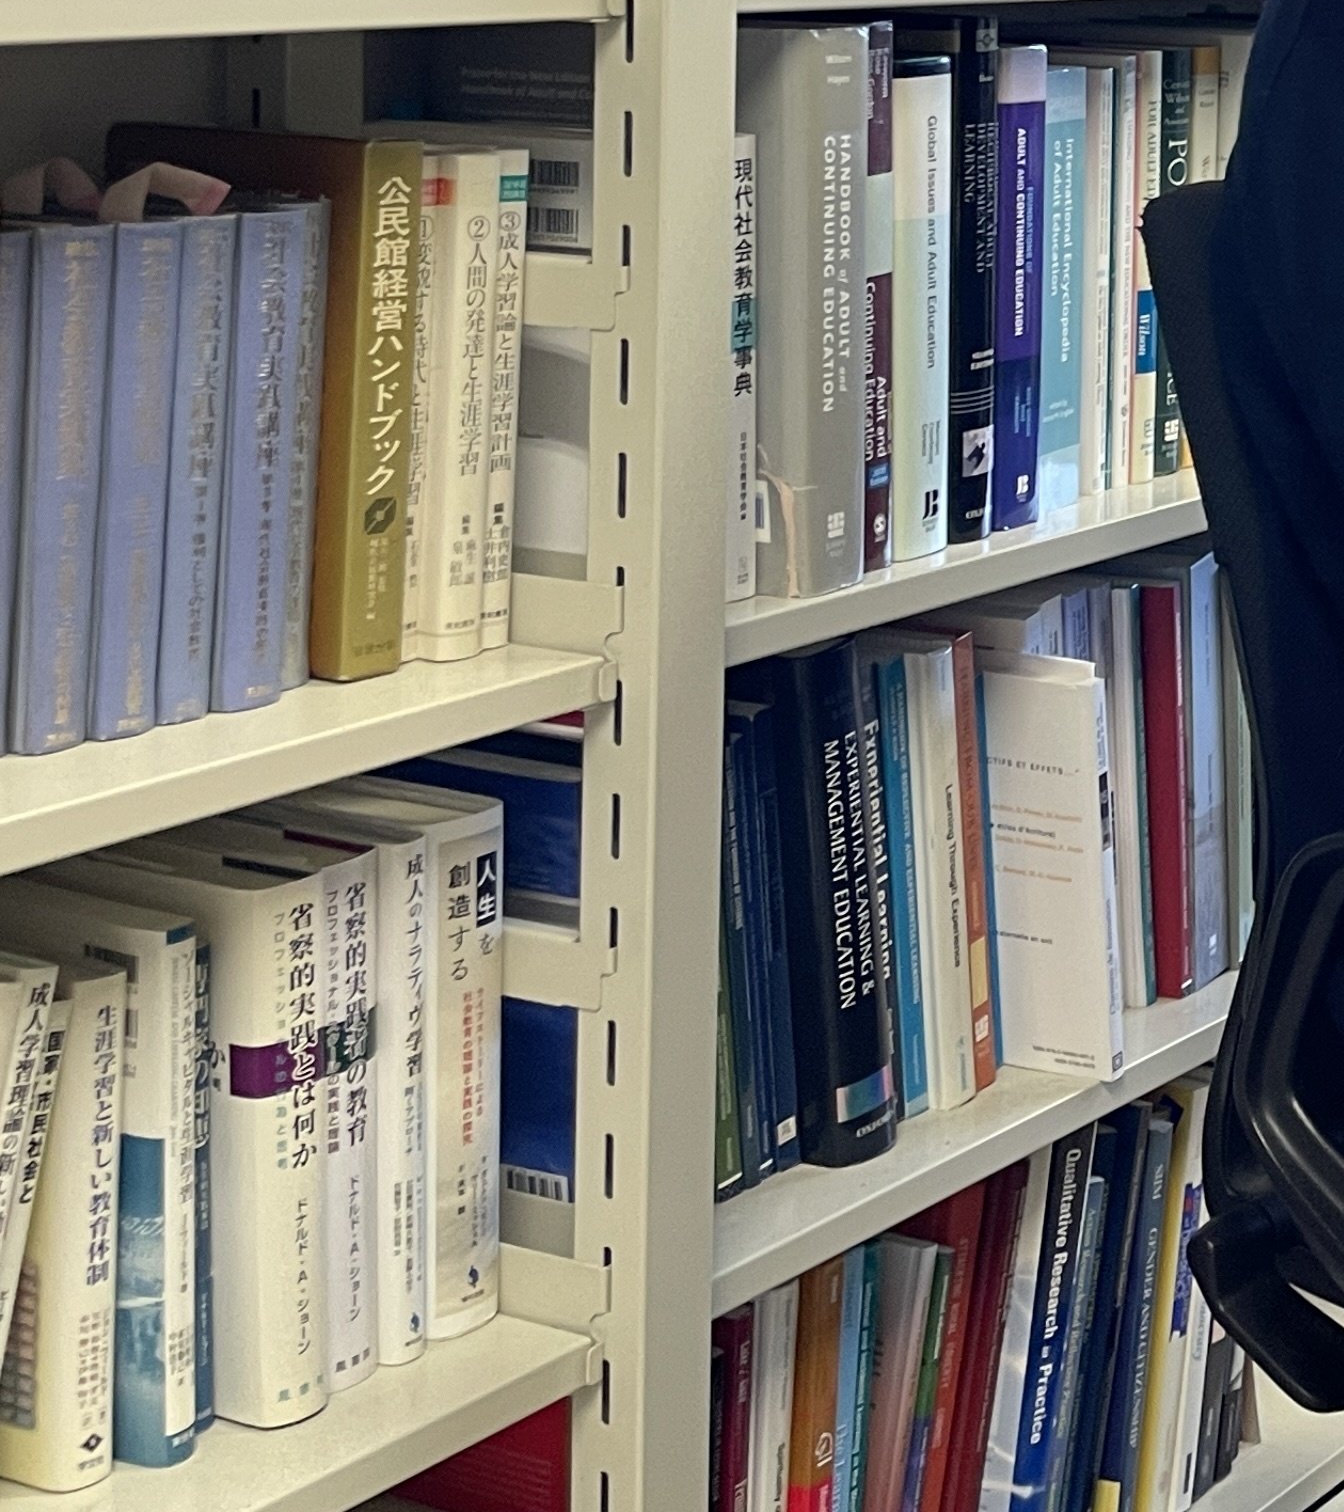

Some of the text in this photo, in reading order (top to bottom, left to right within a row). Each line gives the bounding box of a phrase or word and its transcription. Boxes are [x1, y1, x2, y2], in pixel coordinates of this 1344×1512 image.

[839, 134, 851, 260] HANDBOOK
[963, 123, 977, 203] LEARNING
[1052, 165, 1061, 208] Adult
[733, 157, 754, 397] 現代社会教育学事典
[822, 136, 836, 413] CONTINUING EDUCATION
[926, 115, 938, 369] Global Issues and Adult Education
[1014, 128, 1027, 337] ADULT AND CONTINUING EDUCATION
[1050, 212, 1060, 297] Education
[1060, 138, 1075, 363] International Encyclopedia
[367, 175, 412, 496] 公民館経営ハンドブック
[838, 290, 850, 359] ADULT
[875, 375, 888, 458] Adult and
[844, 730, 867, 872] EXPERIENTIAL
[447, 864, 471, 982] 創造する
[476, 858, 497, 956] 人生を
[823, 738, 857, 1010] MANAGEMENT EDUCATION
[855, 875, 875, 977] LEARNING
[945, 783, 961, 968] Learning Through Experience
[345, 882, 368, 1147] 省察的実践者の教育
[405, 852, 424, 1078] 成人のナラティヴ学習
[288, 902, 318, 1170] 省察的実践とは何か
[86, 1005, 118, 1286] 生涯学習と新しい教育体制
[1055, 1147, 1083, 1249] Qualitative
[1042, 1251, 1069, 1340] Research
[1143, 1227, 1159, 1300] GENDER
[1030, 1362, 1054, 1445] Practice
